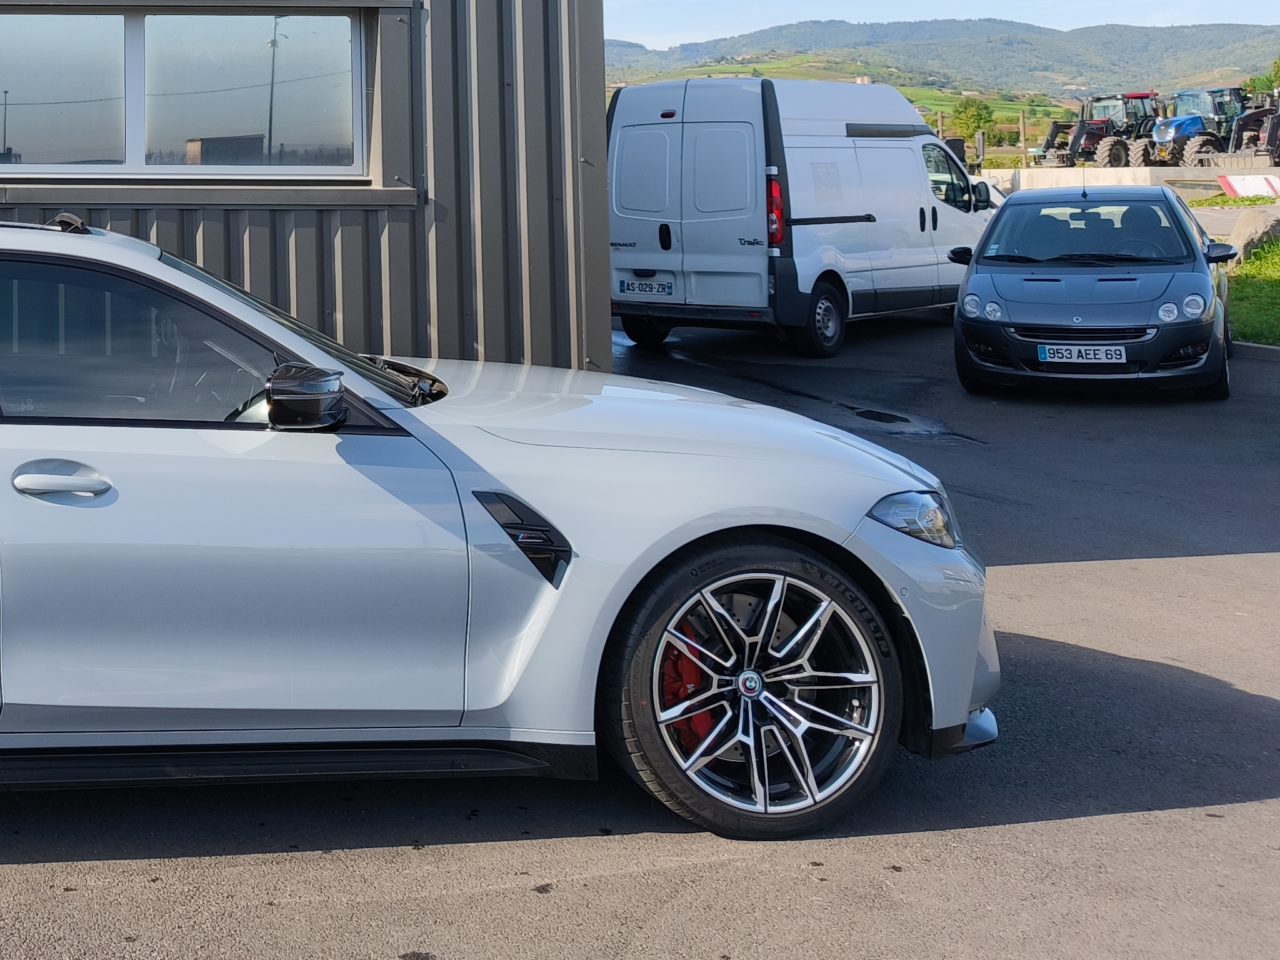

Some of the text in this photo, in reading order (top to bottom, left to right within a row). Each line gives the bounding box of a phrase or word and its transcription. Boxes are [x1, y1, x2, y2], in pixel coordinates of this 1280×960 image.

[1047, 347, 1123, 360] 953 AEE 69
[823, 572, 892, 657] MICHELIN
